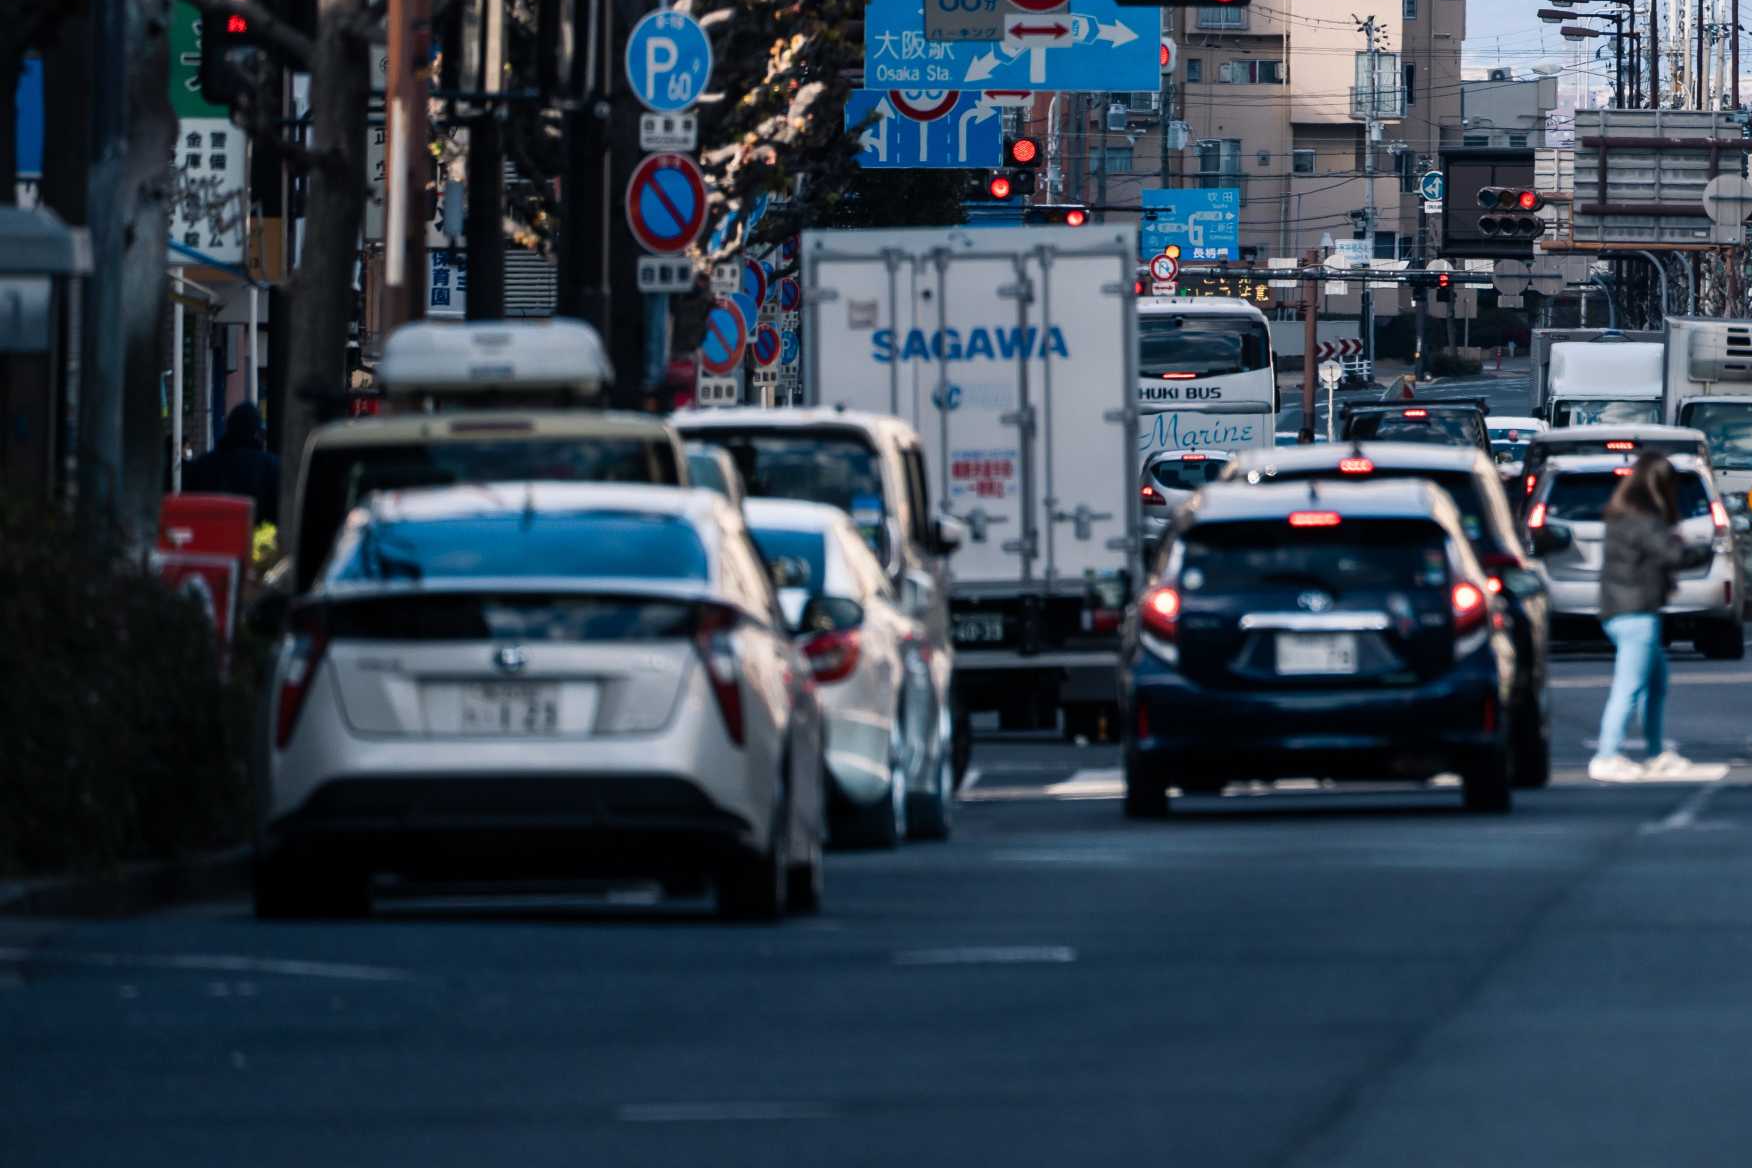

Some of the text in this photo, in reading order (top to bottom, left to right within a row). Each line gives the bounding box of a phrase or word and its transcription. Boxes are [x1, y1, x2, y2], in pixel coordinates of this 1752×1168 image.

[646, 37, 678, 101] P
[876, 65, 919, 81] Osaka
[871, 326, 1069, 364] SAGAWA
[1138, 386, 1222, 400] HUKI BUS
[1141, 413, 1253, 450] Marine
